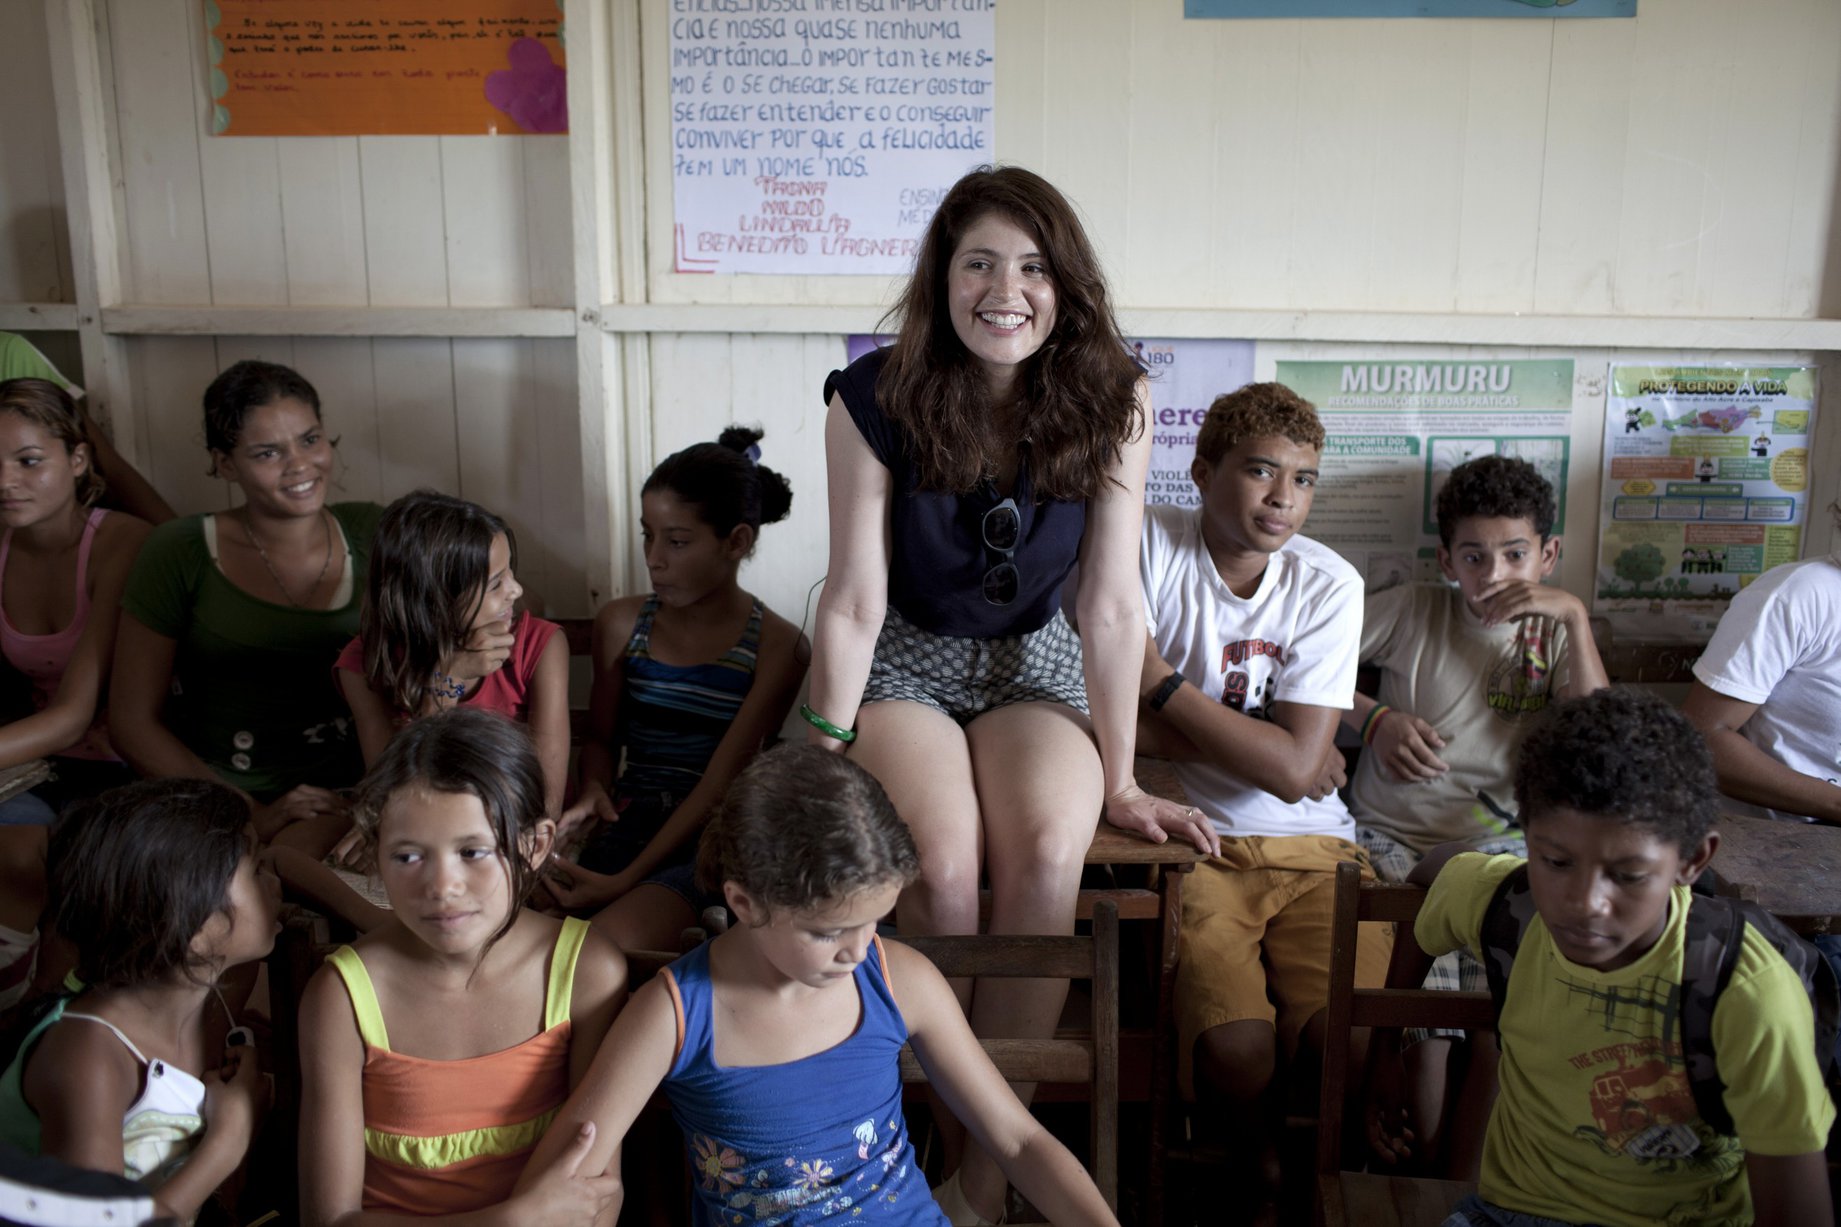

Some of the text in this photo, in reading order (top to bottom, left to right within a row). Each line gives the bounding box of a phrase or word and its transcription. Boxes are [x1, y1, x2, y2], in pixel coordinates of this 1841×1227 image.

[899, 187, 949, 207] ENSIN
[1147, 351, 1175, 364] 180
[1340, 364, 1513, 394] MURMURU
[1638, 379, 1789, 396] PROTEGENDO A VIDA
[1151, 468, 1192, 481] VIOLÊ
[1145, 482, 1194, 493] TO DAS
[1221, 638, 1285, 674] FUTBOL
[1567, 1052, 1594, 1071] THE
